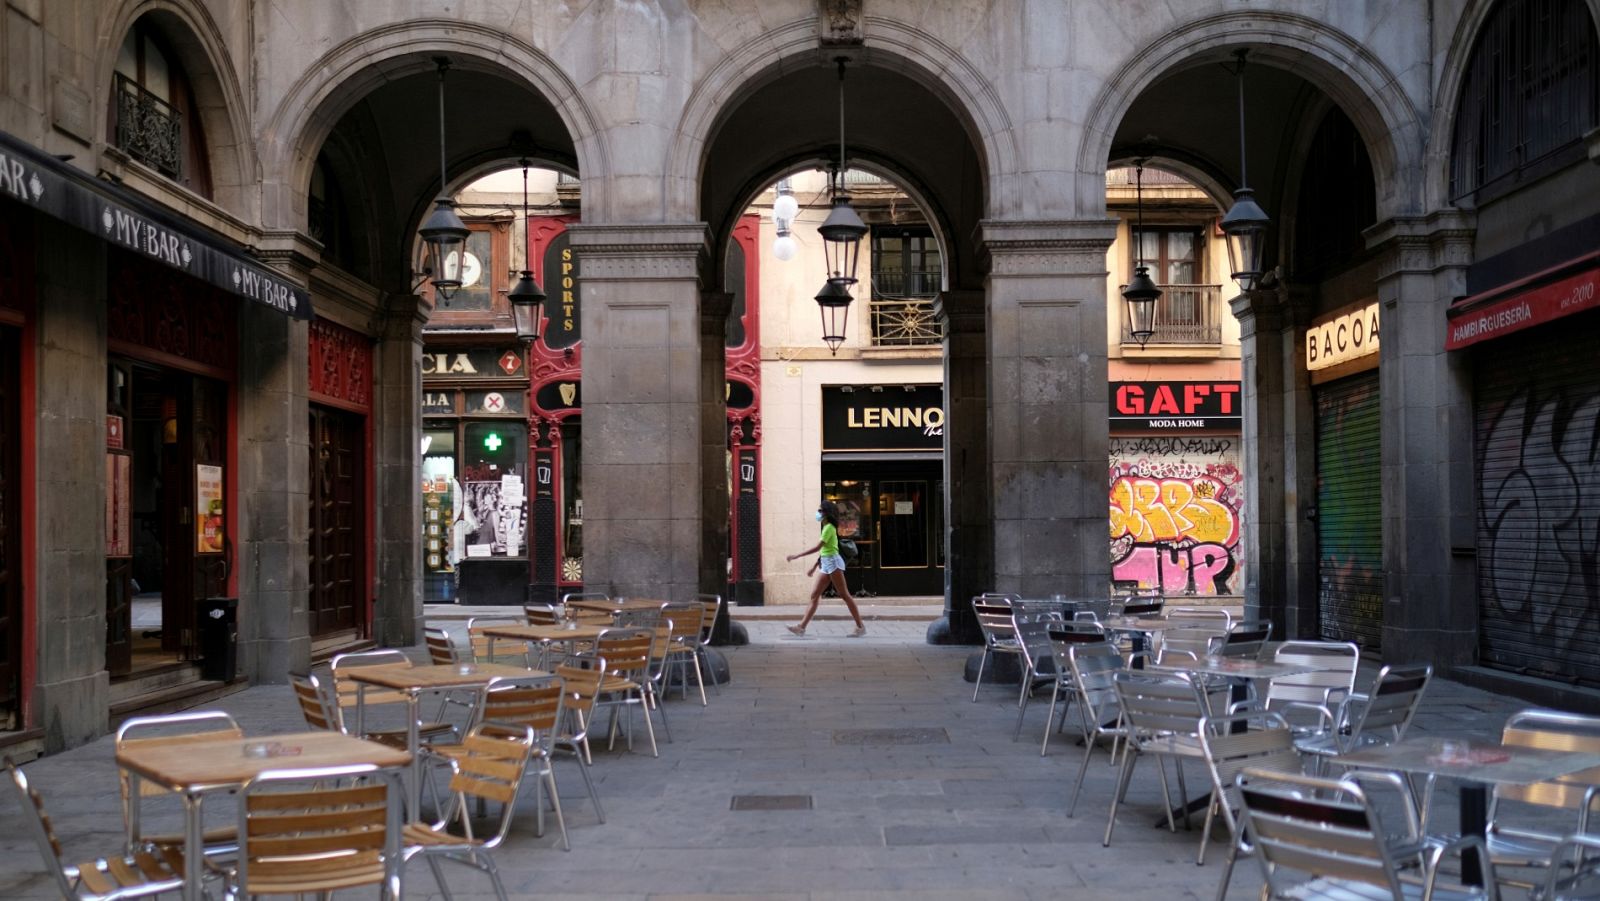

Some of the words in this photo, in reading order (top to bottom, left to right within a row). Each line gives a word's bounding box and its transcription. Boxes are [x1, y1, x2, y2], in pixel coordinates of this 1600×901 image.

[115, 209, 141, 249] MY
[146, 224, 181, 267] BAR
[242, 268, 260, 299] MY
[264, 278, 289, 312] BAR
[561, 248, 574, 332] SPORTS
[1571, 282, 1594, 304] 2010
[1309, 311, 1380, 362] BACOA
[1453, 301, 1532, 342] HAMBURGUESERÍA
[505, 355, 515, 370] 7
[847, 407, 944, 428] LENNO
[1116, 384, 1240, 415] GAFT
[1149, 419, 1177, 428] MODA
[1178, 419, 1205, 428] HOME
